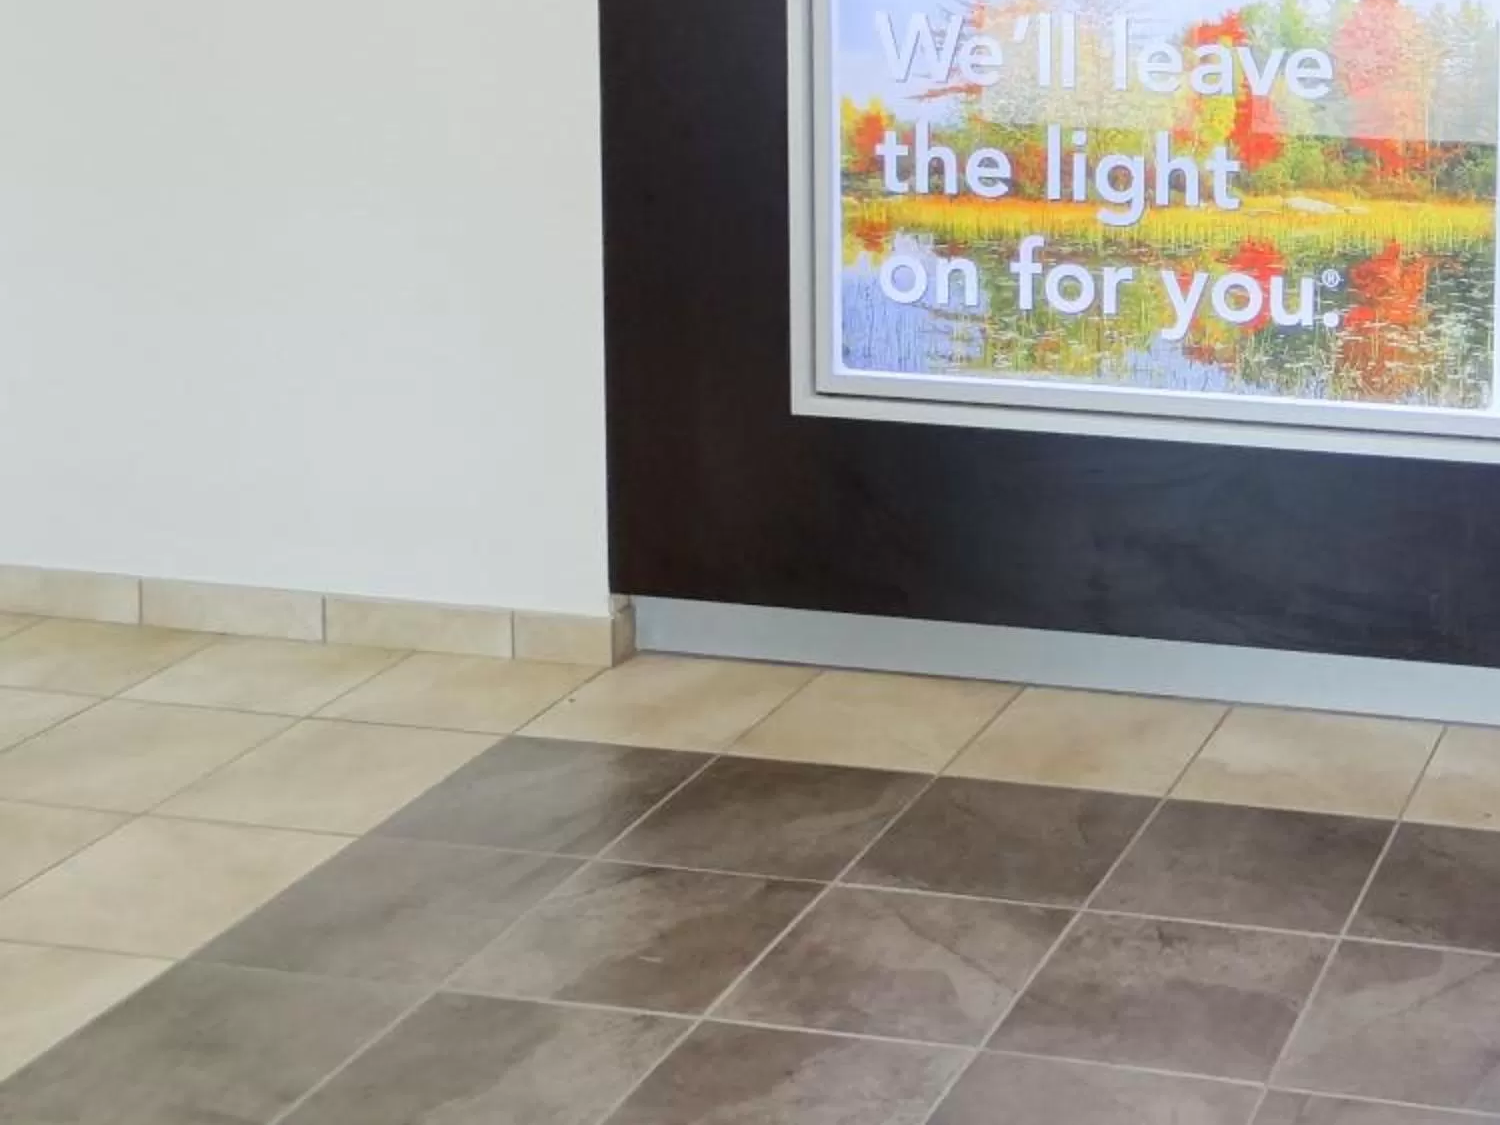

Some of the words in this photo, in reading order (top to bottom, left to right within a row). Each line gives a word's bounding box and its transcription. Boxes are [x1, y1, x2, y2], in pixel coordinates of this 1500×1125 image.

[1112, 16, 1335, 100] leave
[876, 123, 1011, 198] the
[1046, 124, 1242, 227] light
[879, 252, 980, 307] on
[1010, 236, 1133, 315] for
